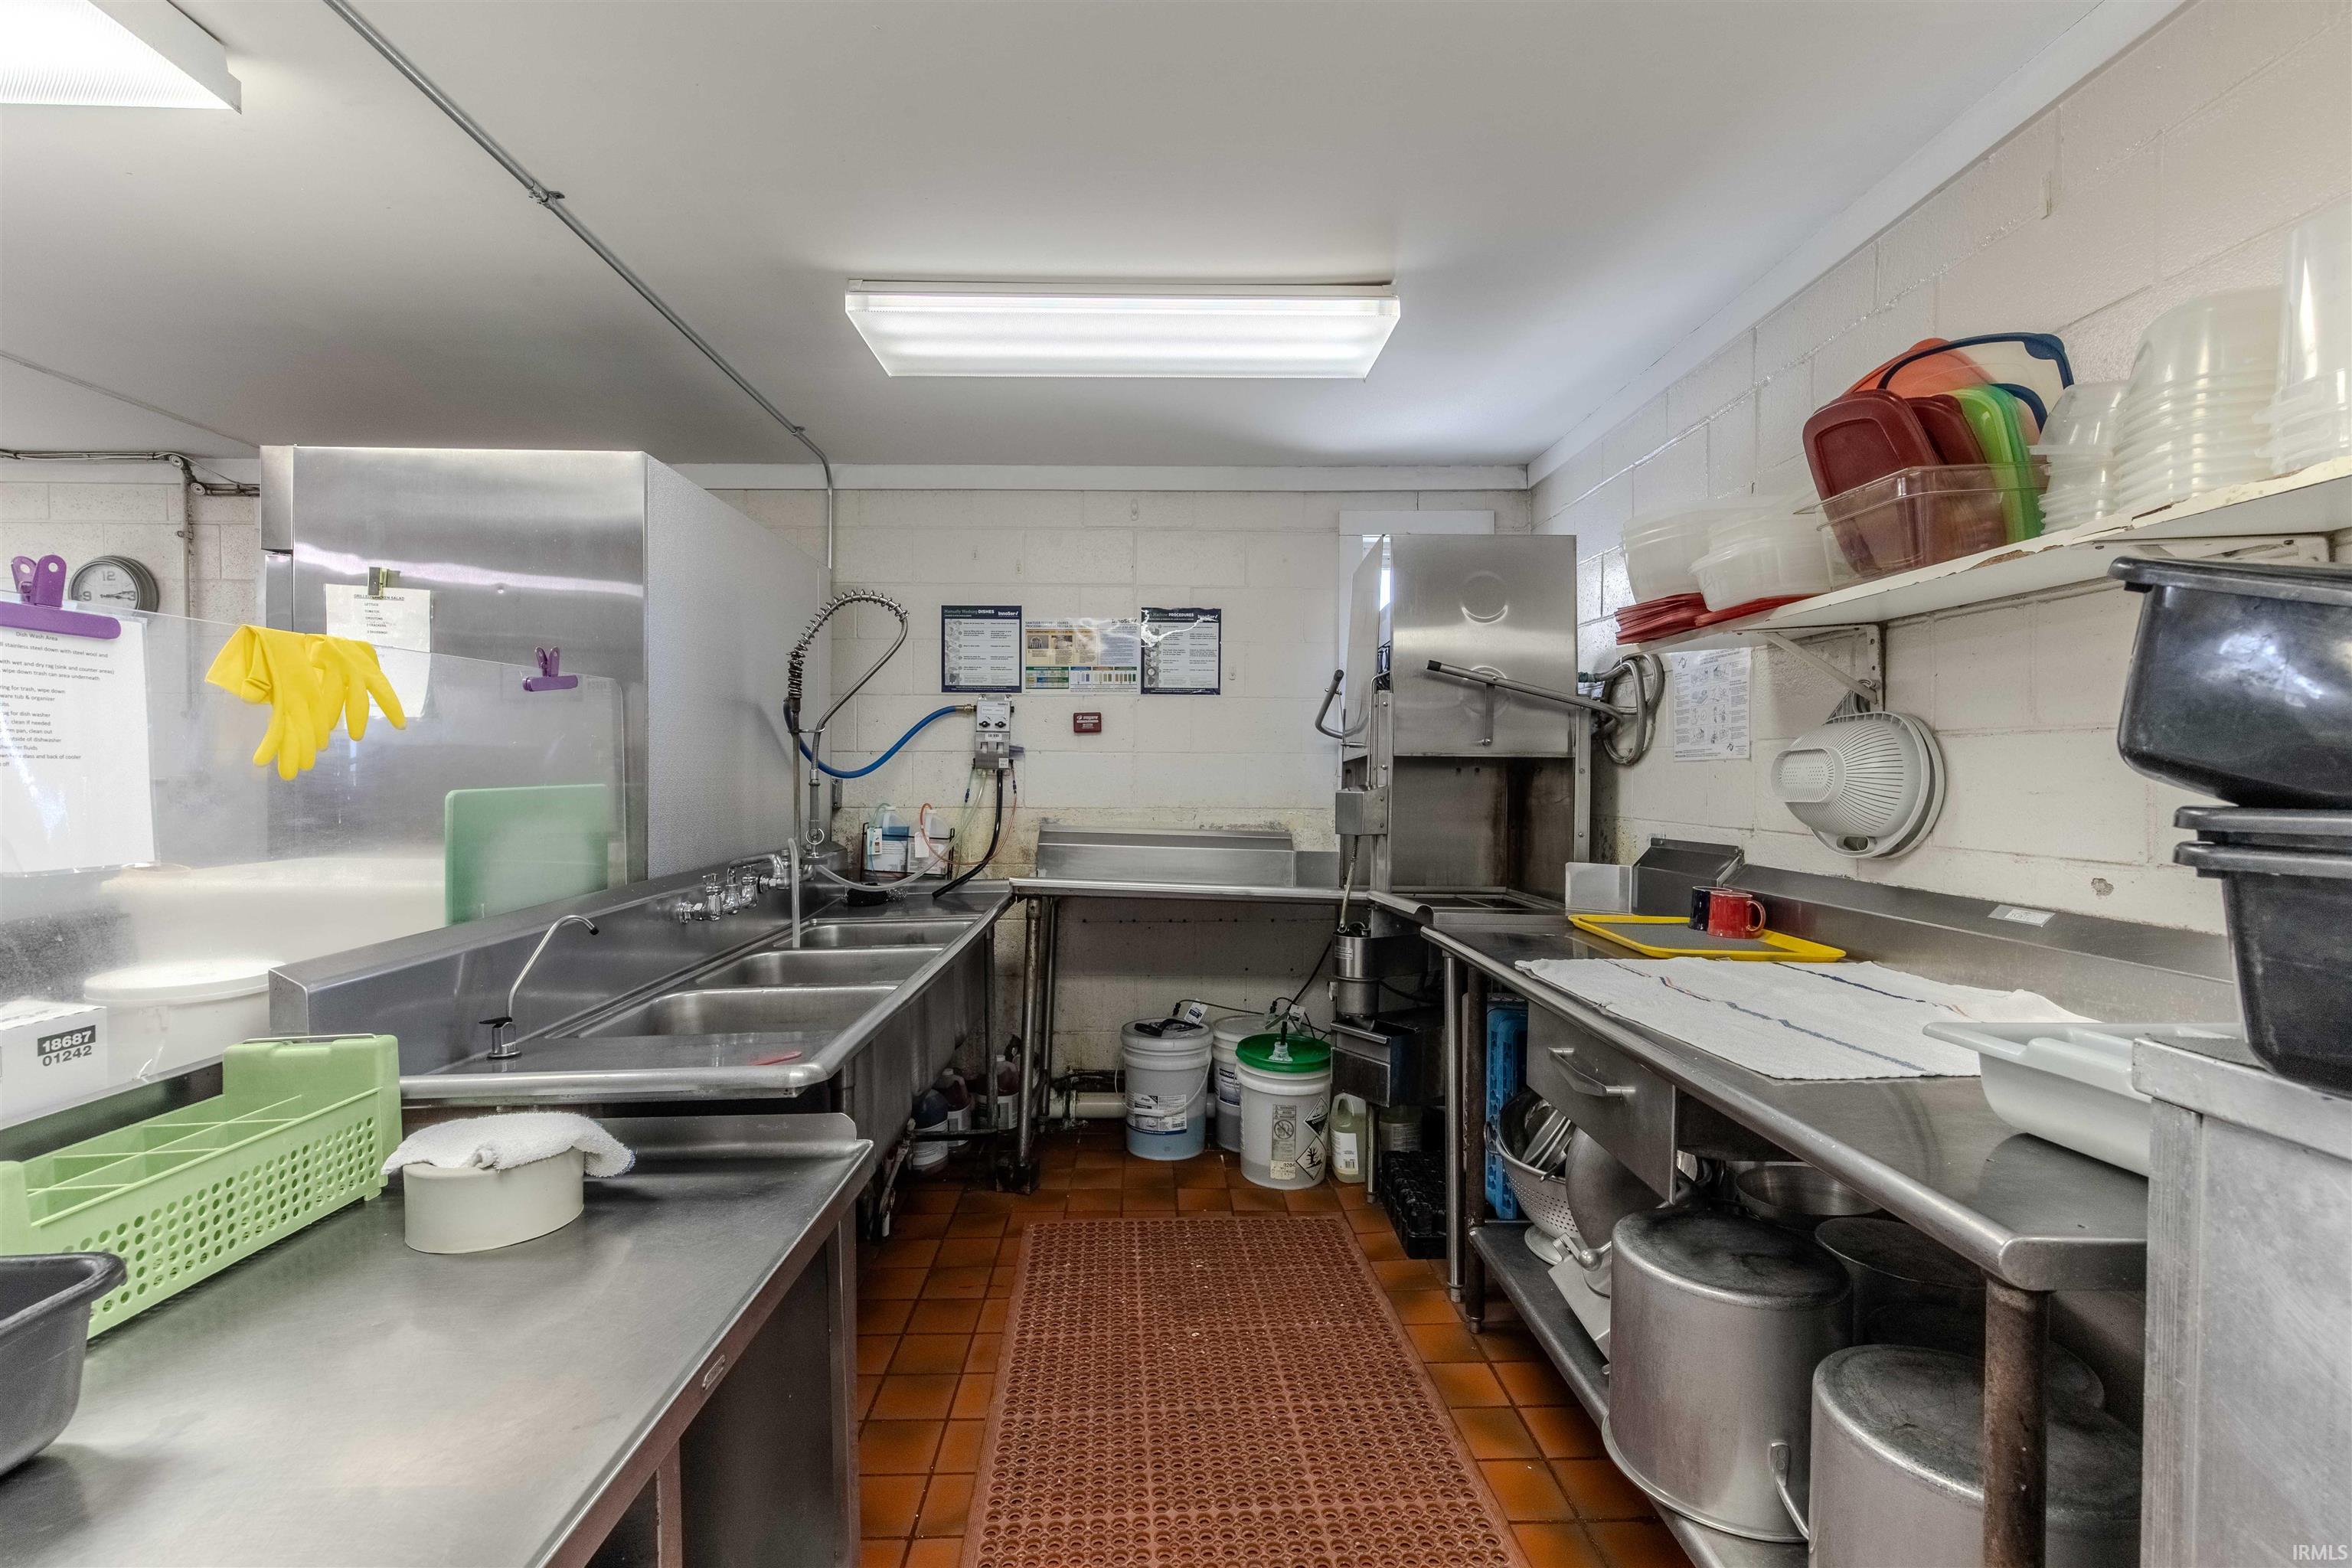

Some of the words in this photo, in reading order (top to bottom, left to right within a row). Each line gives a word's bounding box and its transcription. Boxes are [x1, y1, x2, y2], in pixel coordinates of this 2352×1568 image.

[102, 570, 116, 581] 12
[83, 590, 92, 601] 9
[42, 1031, 92, 1053] 18687
[42, 1045, 92, 1067] 01242
